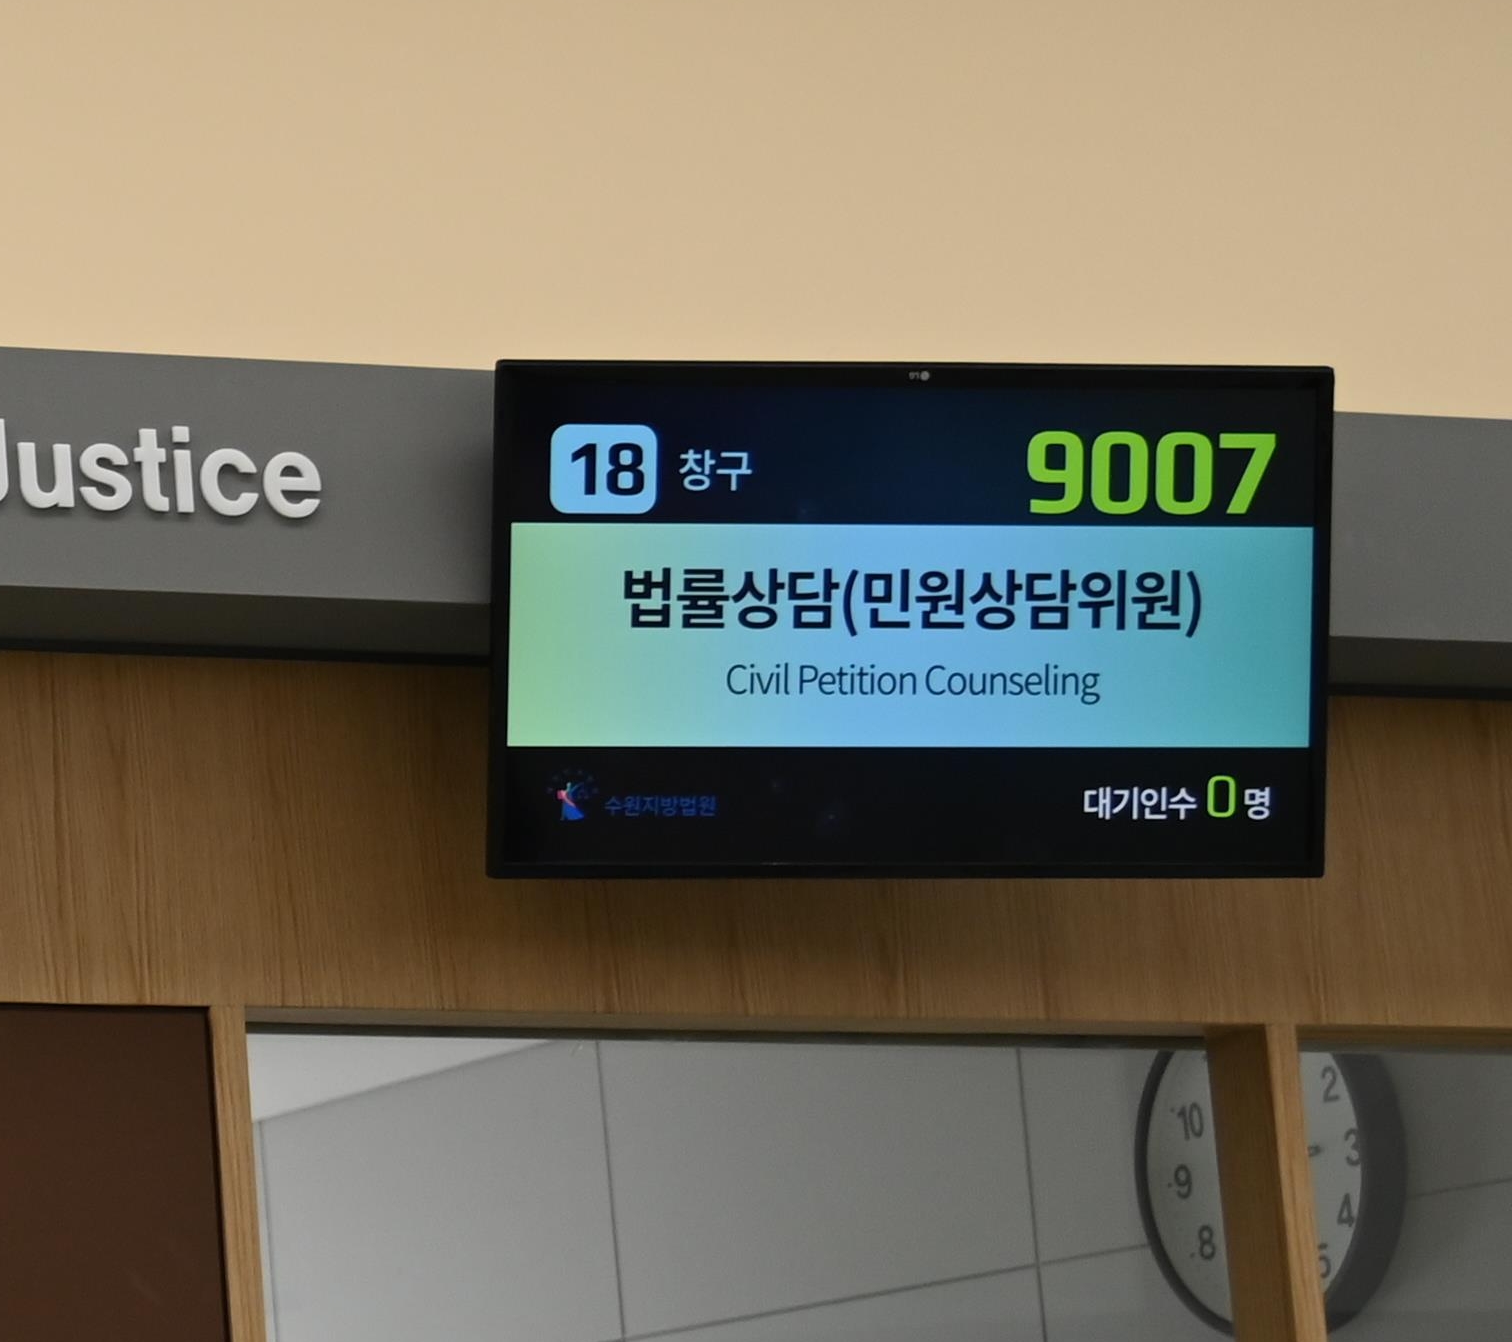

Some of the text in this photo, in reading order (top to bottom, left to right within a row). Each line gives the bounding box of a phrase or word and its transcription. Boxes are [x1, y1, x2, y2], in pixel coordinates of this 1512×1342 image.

[568, 442, 753, 496] 18 창구
[1026, 430, 1277, 515] 9007
[622, 568, 1203, 637] 법률상담(민원상담위원)
[726, 663, 1101, 703] Civil Petition Counseling
[605, 796, 716, 817] 수원지방법원
[1084, 775, 1271, 821] 대기인수 0 명
